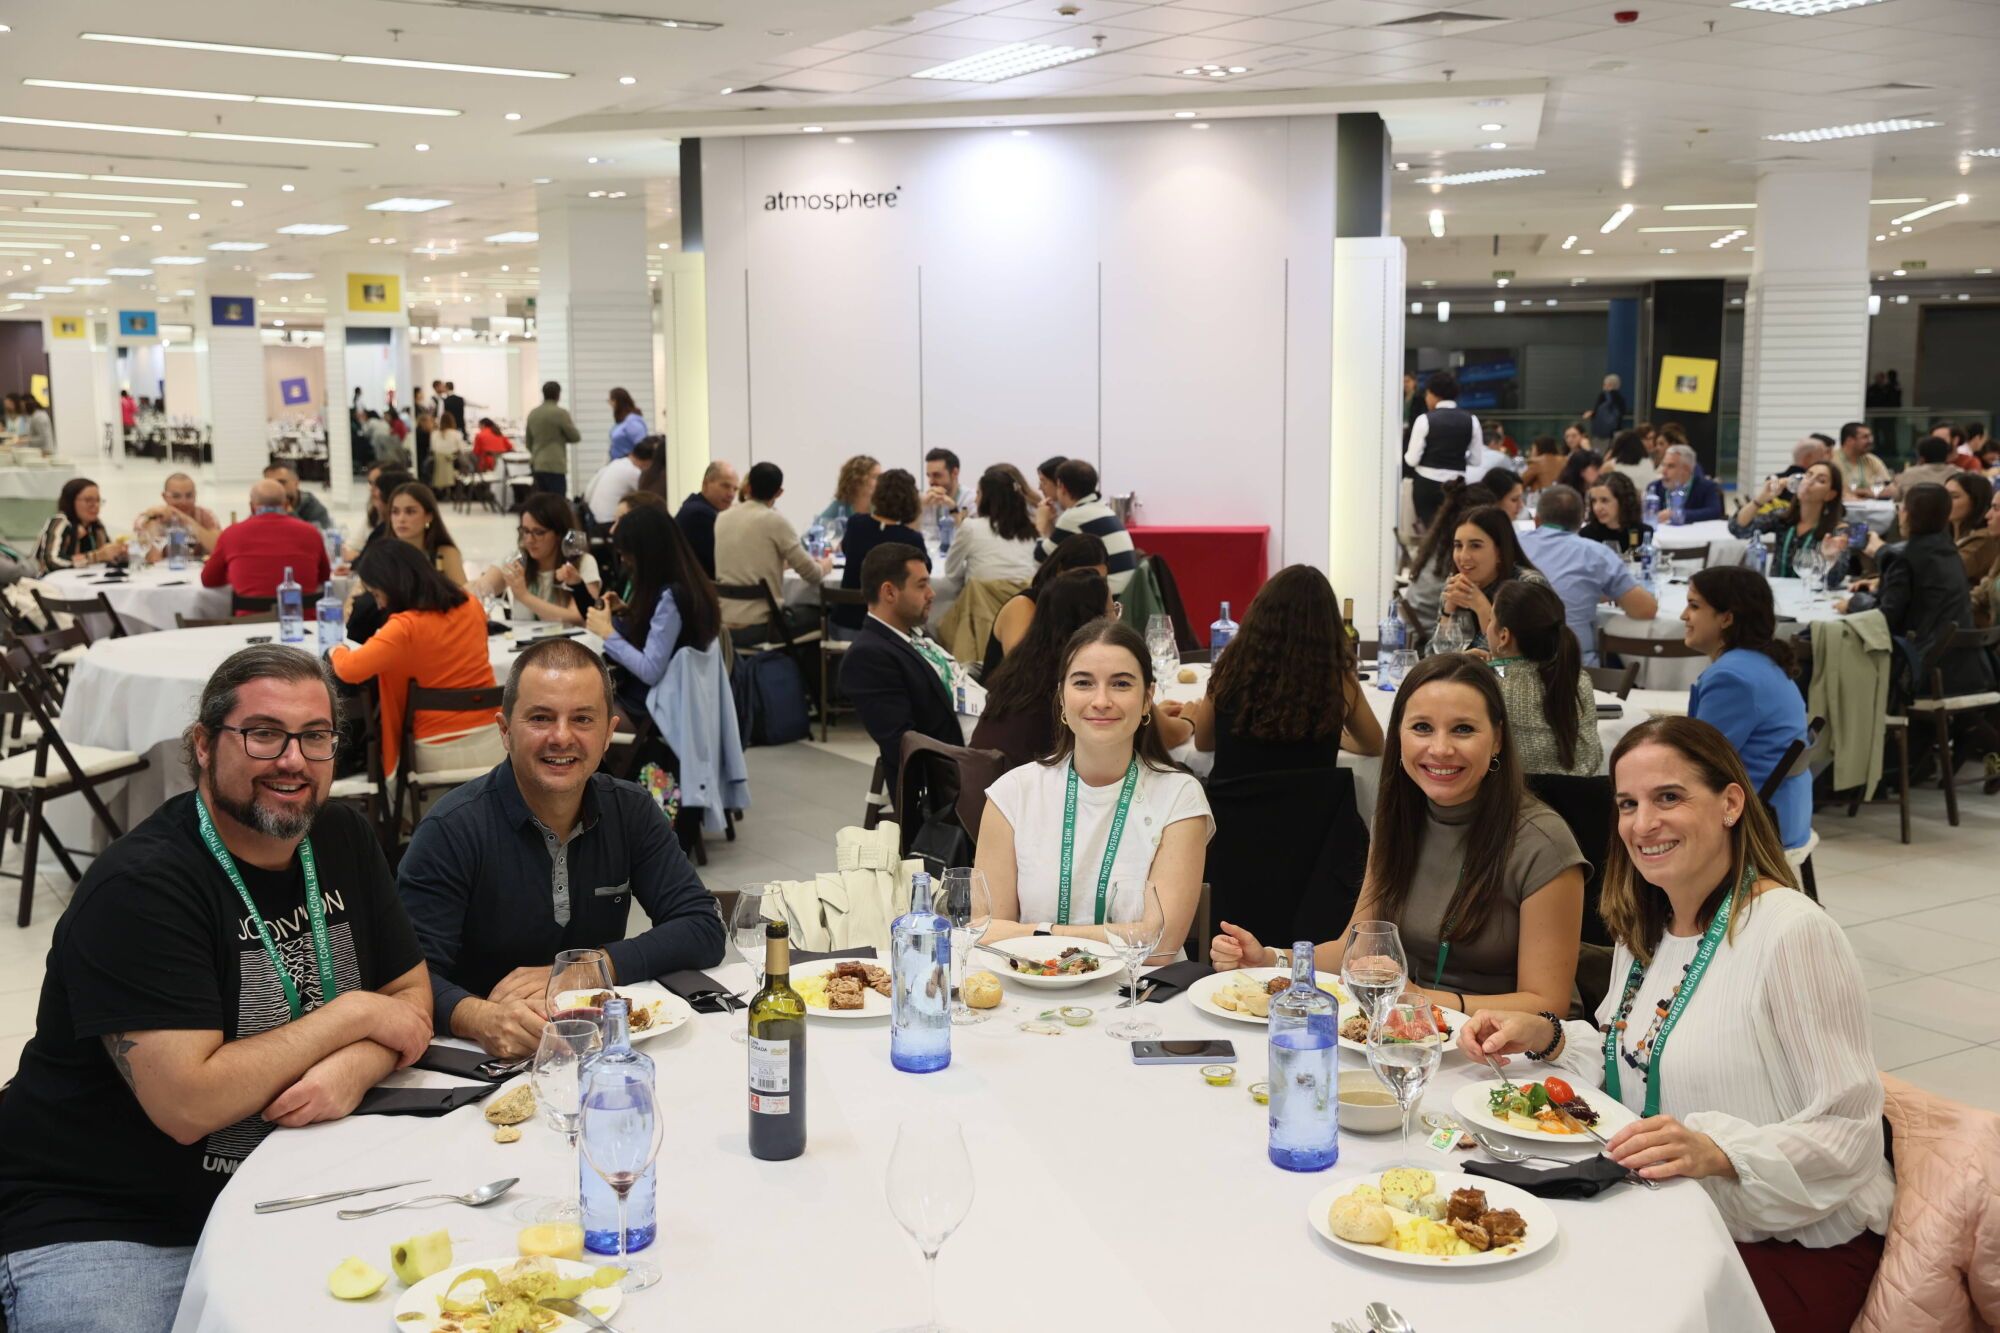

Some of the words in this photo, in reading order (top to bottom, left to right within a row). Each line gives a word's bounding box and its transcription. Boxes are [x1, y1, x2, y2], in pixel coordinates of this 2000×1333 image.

[1067, 780, 1076, 813] CONGRESO
[1109, 818, 1123, 851] CONGRESO
[306, 861, 316, 880] SEHH
[1062, 845, 1071, 876] NACIONAL
[1101, 851, 1113, 881] NACIONAL
[200, 814, 221, 851] NACIONAL
[216, 850, 232, 871] SEHH
[237, 886, 260, 923] CONGRESO
[257, 923, 277, 959] NACIONAL
[273, 958, 287, 979] SETH
[308, 881, 324, 919] NACIONAL
[1060, 876, 1070, 909] CONGRESO
[314, 919, 329, 960] CONGRESO
[321, 961, 333, 981] LXVII
[1653, 1035, 1664, 1056] LXVII
[1662, 997, 1685, 1036] CONGRESO
[1681, 961, 1706, 998] NACIONAL
[1701, 940, 1716, 961] SEHH
[1606, 1042, 1615, 1061] SETH
